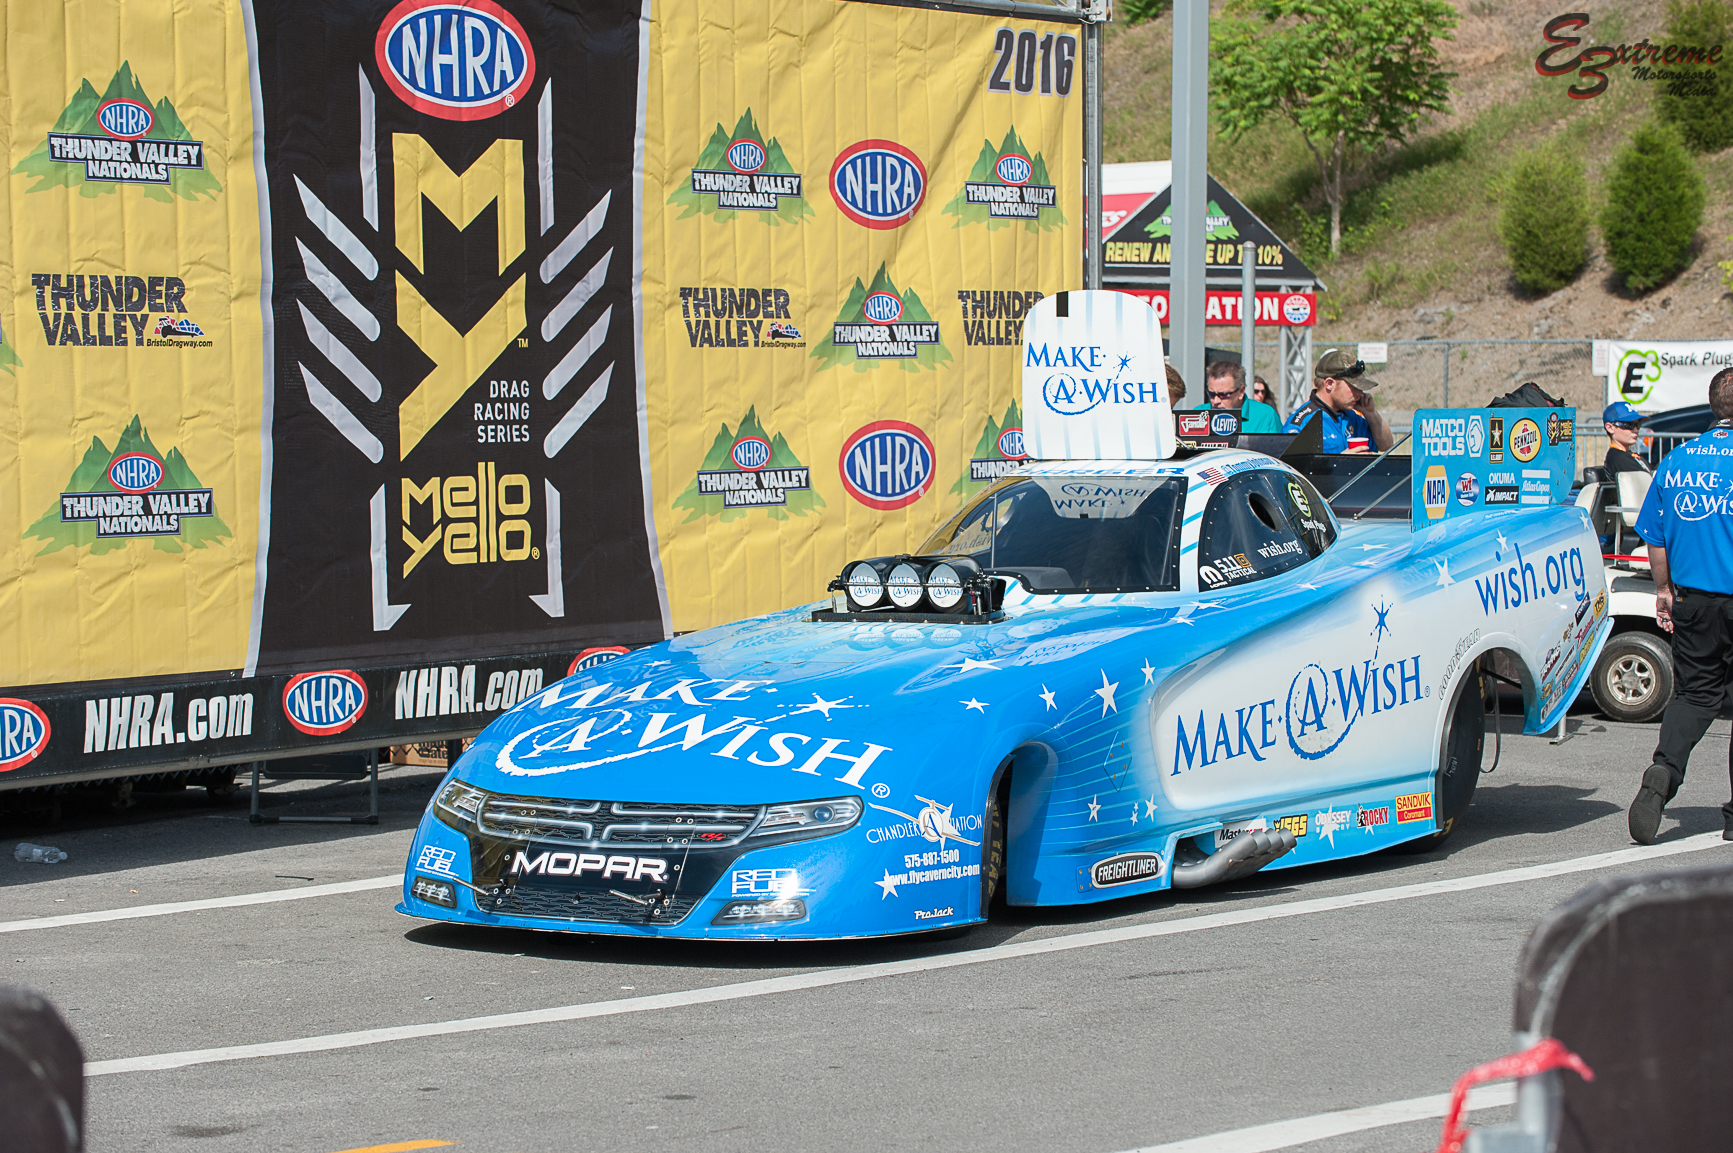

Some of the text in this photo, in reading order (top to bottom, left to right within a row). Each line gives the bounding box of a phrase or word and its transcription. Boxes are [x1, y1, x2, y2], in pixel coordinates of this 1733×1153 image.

[402, 14, 515, 98] NHRA
[987, 26, 1077, 98] 2016
[105, 105, 146, 134] NHRA
[51, 137, 200, 165] THUNDER VALLEY
[732, 144, 763, 169] NHRA
[88, 160, 168, 180] NATIONALS
[999, 157, 1030, 182] NHRA
[693, 172, 800, 194] THUNDER VALLEY
[845, 155, 916, 214] NHRA
[719, 192, 777, 208] NATIONALS
[966, 184, 1055, 205] THUNDER VALLEY
[990, 202, 1039, 217] NATIONALS
[1105, 242, 1152, 263] RENEW
[1153, 243, 1171, 263] AN
[1216, 244, 1238, 265] UP
[1257, 245, 1283, 265] 10%
[32, 274, 188, 313] THUNDER
[679, 287, 791, 319] THUNDER
[865, 295, 899, 321] NHRA
[38, 312, 150, 346] VALLEY
[684, 319, 763, 347] VALLEY
[835, 324, 939, 343] THUNDER VALLEY
[147, 338, 213, 348] BristolDragway.com
[857, 342, 916, 357] NATIONALS
[1026, 343, 1102, 373] MAKE
[1661, 352, 1698, 369] Spark
[1702, 352, 1733, 367] Plug
[490, 380, 529, 398] DRAG
[474, 403, 530, 421] RACING
[1212, 413, 1237, 432] CLEVITE
[478, 425, 530, 443] SERIES
[1422, 419, 1465, 437] MATCO
[1422, 437, 1465, 456] TOOLS
[1514, 429, 1538, 450] PENNZOIL
[737, 442, 767, 468] NHRA
[855, 435, 924, 494] NHRA
[116, 459, 157, 489] NHRA
[699, 470, 808, 491] THUNDER VALLEY
[1489, 473, 1516, 485] OKUMA
[1664, 469, 1720, 491] MAKE
[725, 488, 785, 505] NATIONALS
[1426, 480, 1446, 505] NAPA
[1495, 491, 1518, 501] IMPACT
[63, 492, 210, 518] THUNDER VALLEY
[99, 514, 178, 534] NATIONALS
[1257, 540, 1303, 558] wish.org
[1225, 567, 1257, 580] TACTICAL
[1475, 542, 1586, 617] wish.org
[294, 678, 357, 723] NHRA
[395, 665, 543, 720] NHRA.com
[503, 679, 774, 715] MAKE
[84, 692, 253, 753] NHRA.com
[1171, 699, 1279, 777] MAKE
[1397, 793, 1431, 811] SANDVIK
[1315, 810, 1351, 826] ODYSSEY
[1364, 807, 1389, 826] ROCKY
[866, 822, 921, 843] CHANDLER
[421, 845, 457, 863] RED
[905, 848, 950, 869] 575-887-1500
[510, 851, 669, 884] MOPAR
[732, 868, 797, 881] RED
[1097, 857, 1157, 882] FREIGHTLINER
